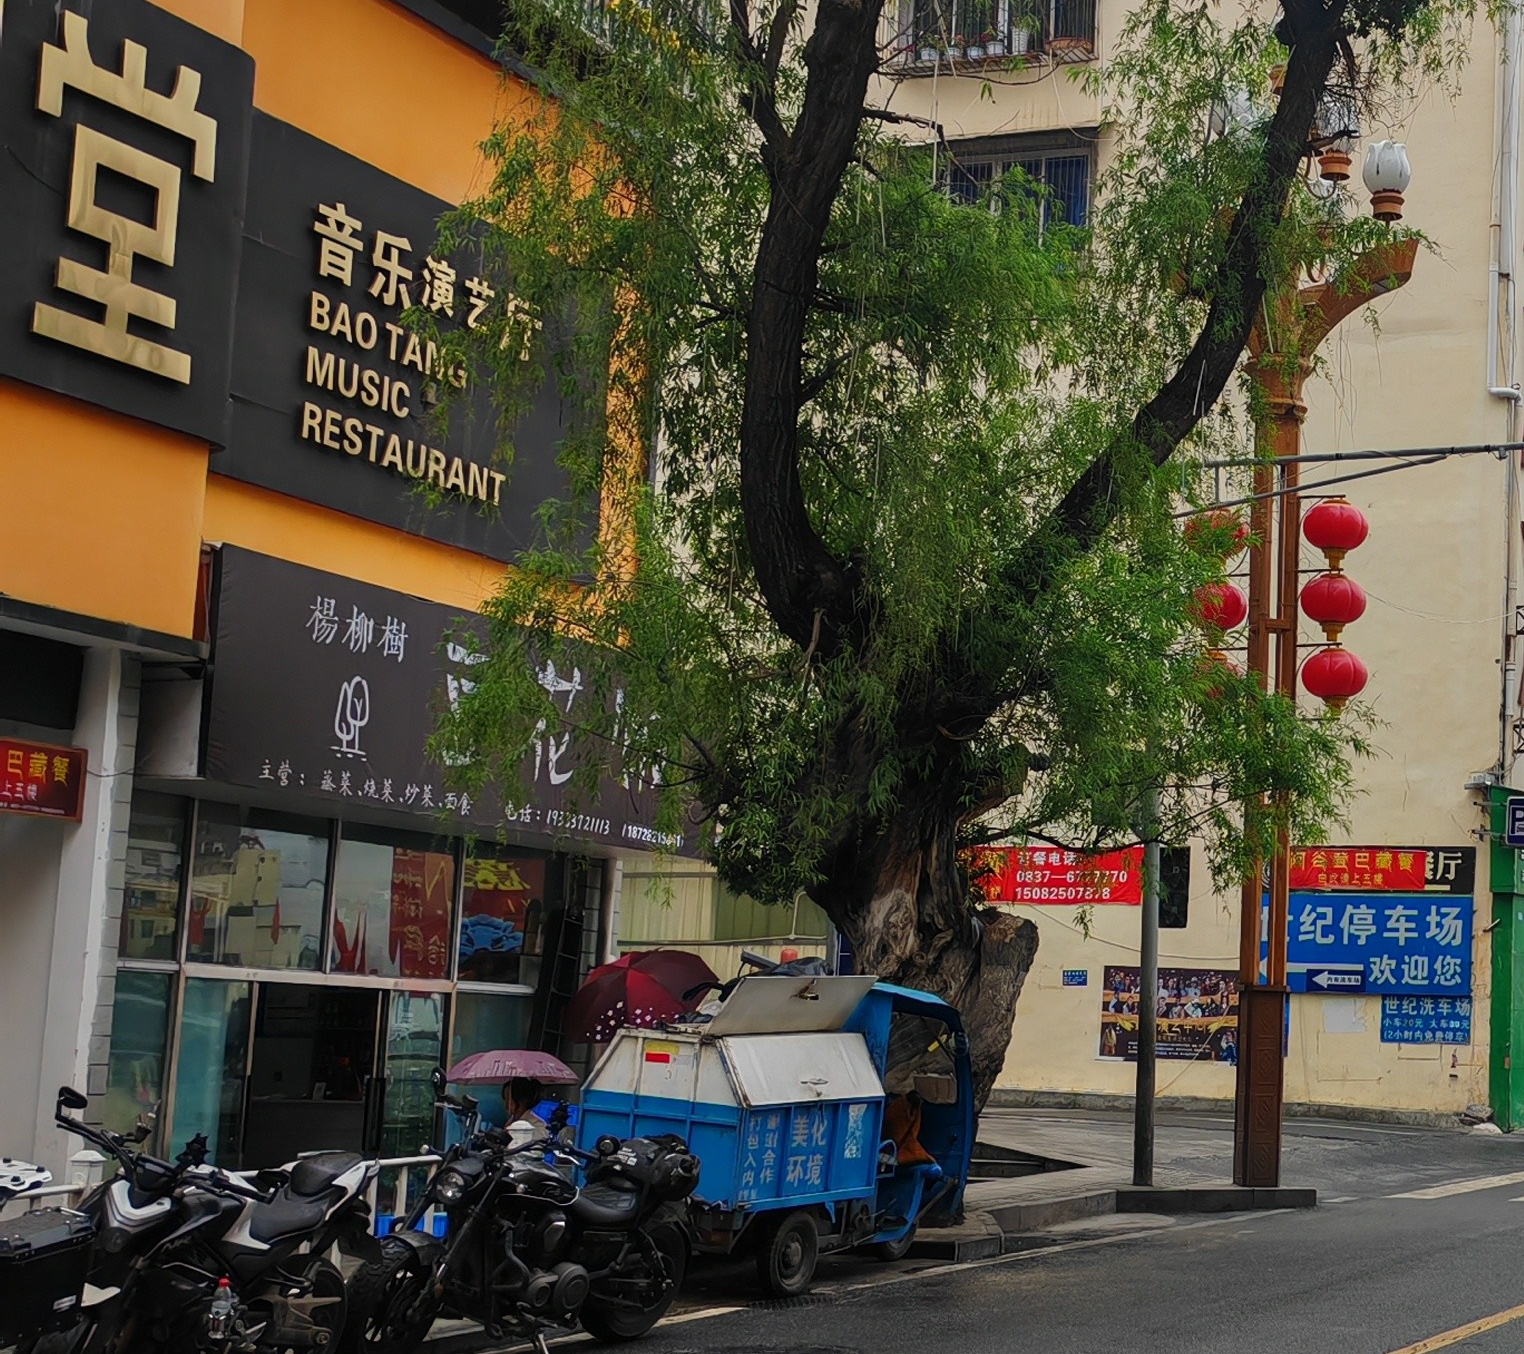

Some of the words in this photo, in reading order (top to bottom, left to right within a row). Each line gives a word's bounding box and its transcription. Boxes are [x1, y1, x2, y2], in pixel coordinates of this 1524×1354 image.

[313, 202, 543, 361] 音乐演艺厅
[310, 291, 378, 350] BAO
[385, 322, 467, 389] TANG
[306, 346, 411, 418] MUSIC
[302, 401, 505, 506] RESTAURANT
[1369, 954, 1462, 986] 欢迎您
[1384, 996, 1471, 1016] 世纪洗车场
[791, 1115, 828, 1148] 美化
[785, 1154, 824, 1188] 环境
